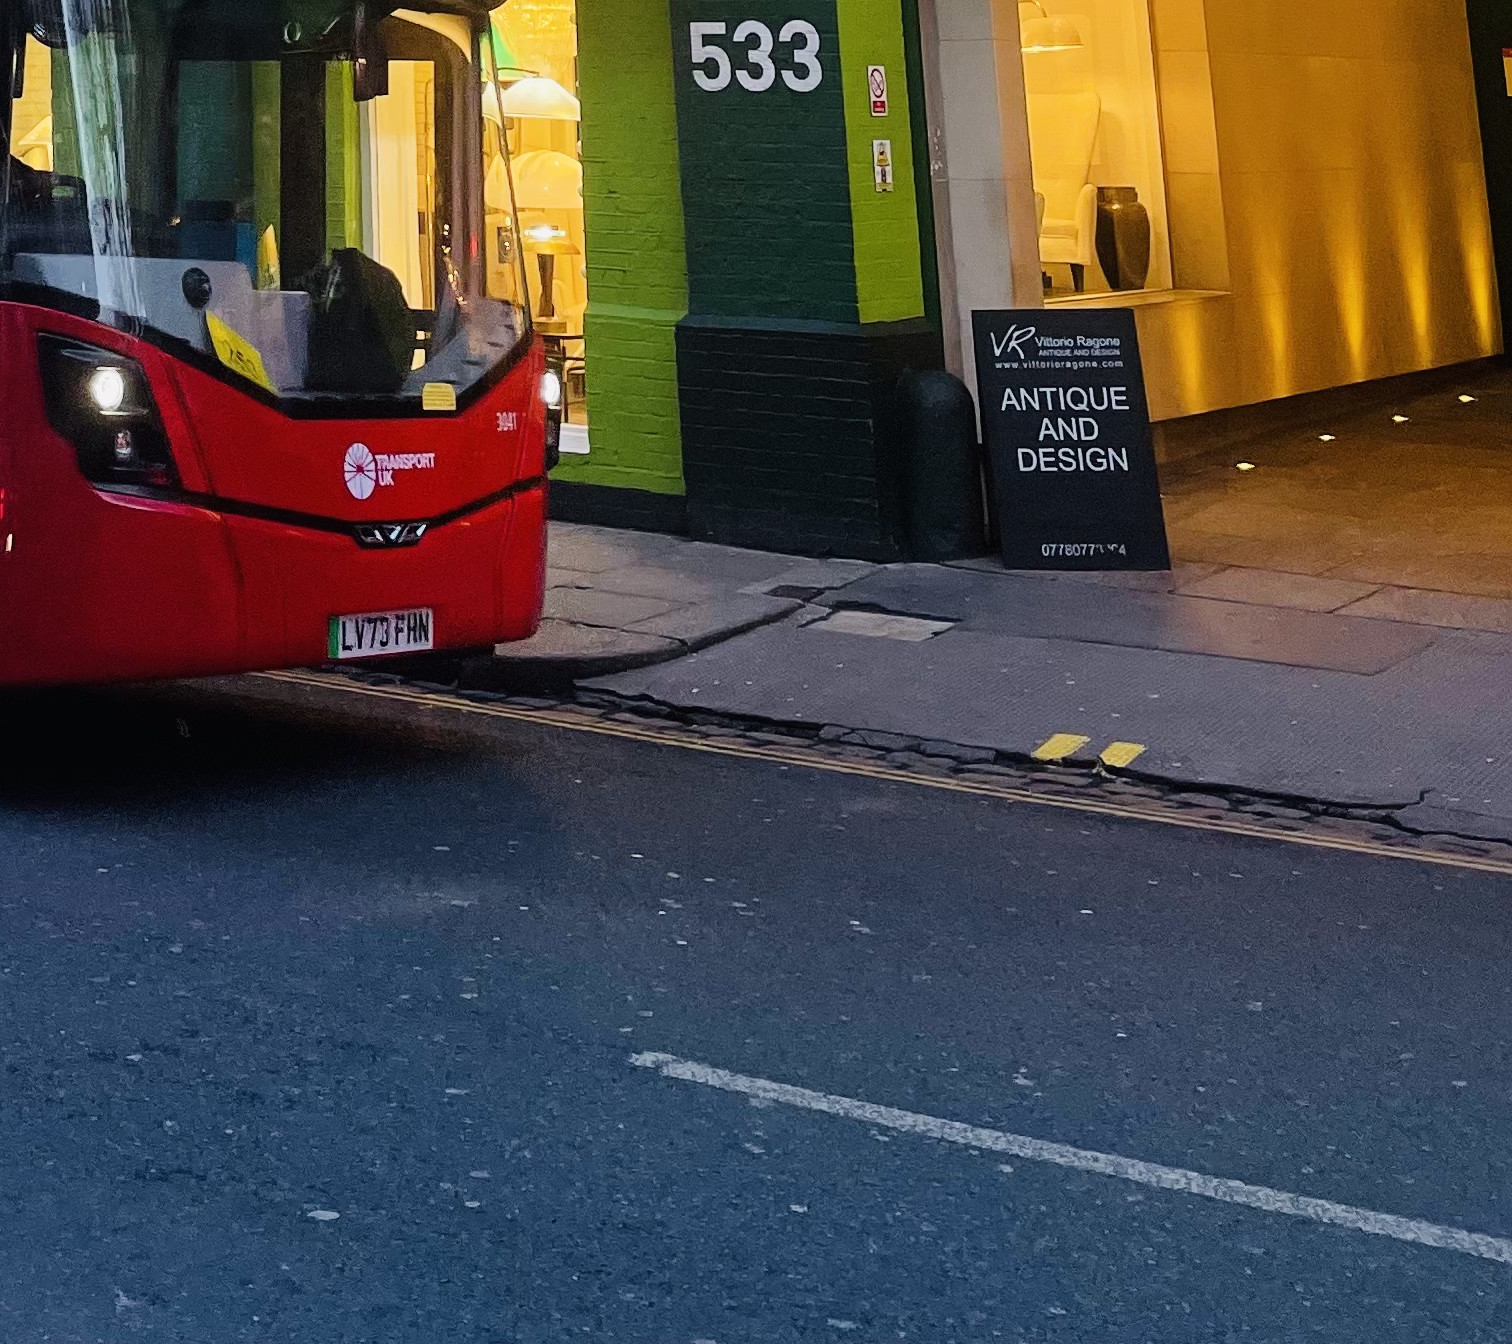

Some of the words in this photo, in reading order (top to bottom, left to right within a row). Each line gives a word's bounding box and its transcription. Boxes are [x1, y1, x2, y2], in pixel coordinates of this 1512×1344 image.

[690, 19, 824, 93] 533
[990, 324, 1036, 359] VR
[1035, 335, 1074, 348] Vittorio
[1076, 335, 1121, 349] Ragone
[1001, 386, 1130, 412] ANTIQUE
[1038, 417, 1099, 442] AND
[374, 452, 436, 470] TRANSPORT
[1017, 447, 1129, 472] DESIGN
[377, 469, 395, 487] UK
[341, 616, 389, 652] LV73
